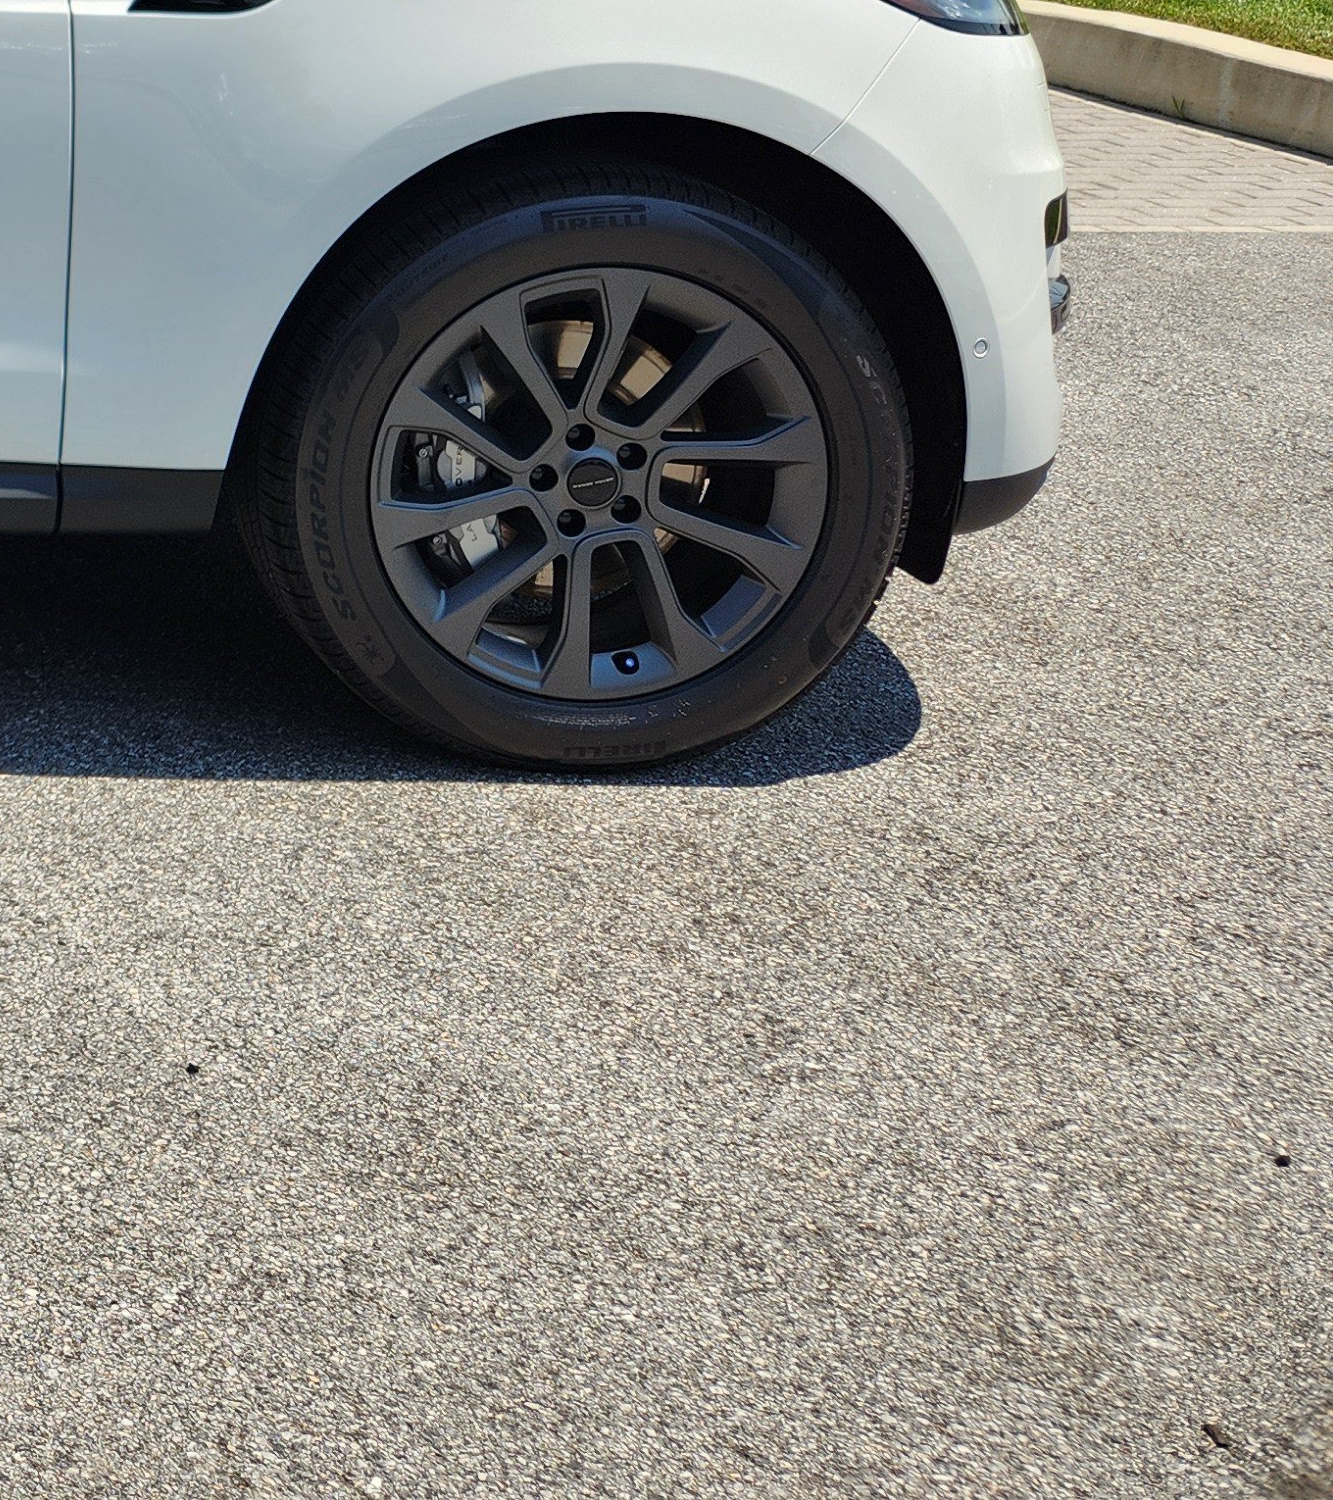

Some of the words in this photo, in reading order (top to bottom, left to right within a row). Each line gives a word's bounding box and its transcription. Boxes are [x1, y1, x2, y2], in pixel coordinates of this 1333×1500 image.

[541, 202, 648, 234] PIRELLI
[454, 445, 465, 487] OVER
[310, 408, 358, 626] SCORPION
[466, 523, 478, 542] LA
